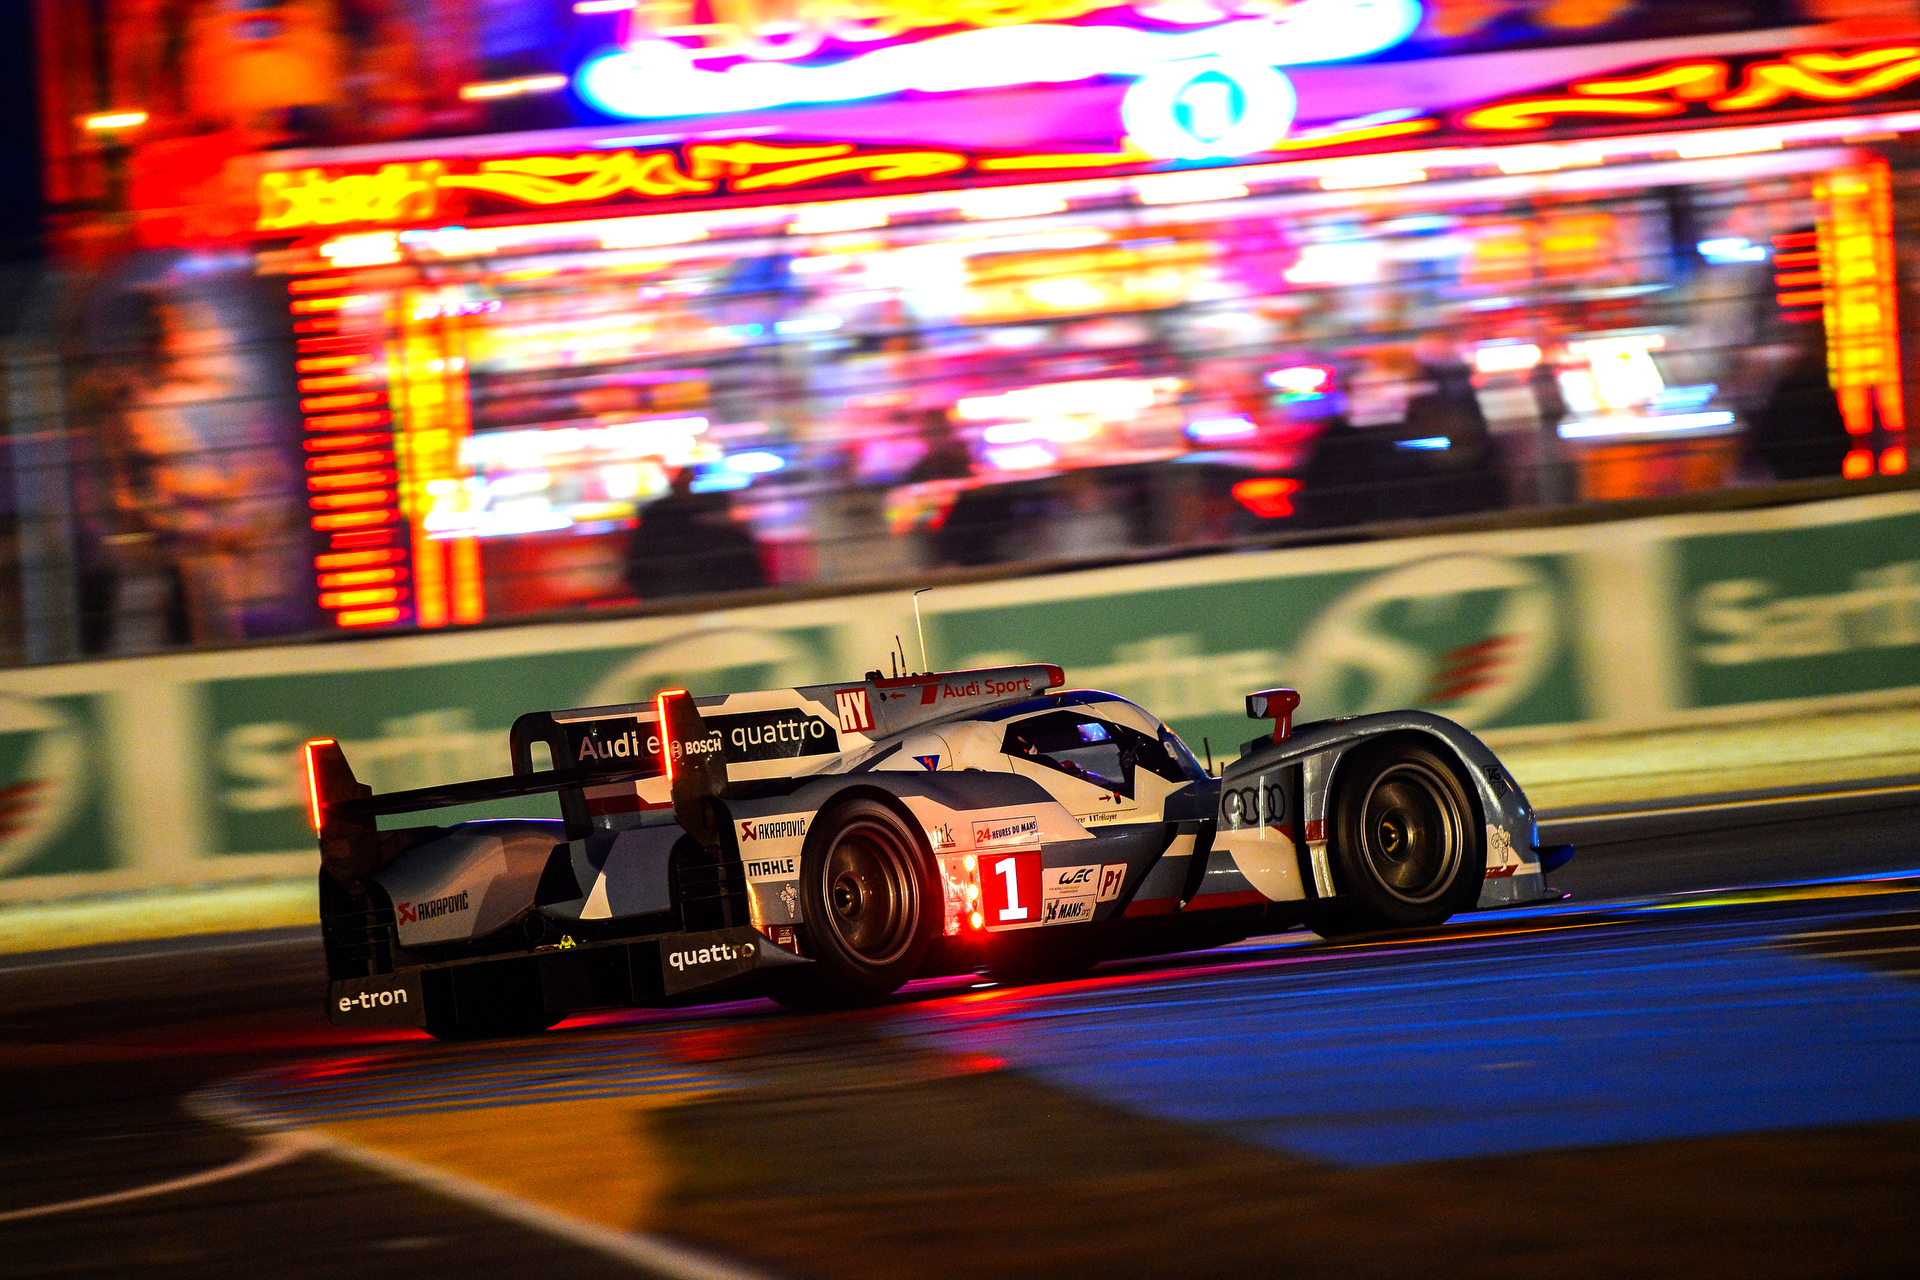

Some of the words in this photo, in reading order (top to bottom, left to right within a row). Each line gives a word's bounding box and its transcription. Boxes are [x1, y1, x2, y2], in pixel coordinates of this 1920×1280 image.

[943, 681, 980, 699] Audi
[985, 677, 1030, 697] Sport
[836, 691, 869, 731] HY
[578, 731, 639, 761] Audi
[731, 719, 826, 752] quattro
[685, 738, 722, 755] BOSCH
[976, 827, 991, 843] 24
[992, 827, 1011, 840] HEURES
[1012, 825, 1020, 834] DU
[1021, 820, 1037, 832] MANS
[748, 859, 794, 877] MAHLE
[1058, 868, 1094, 885] WEC
[995, 857, 1028, 921] 1
[1101, 869, 1123, 897] P1
[669, 943, 755, 971] quattro
[339, 988, 408, 1012] e-tron
